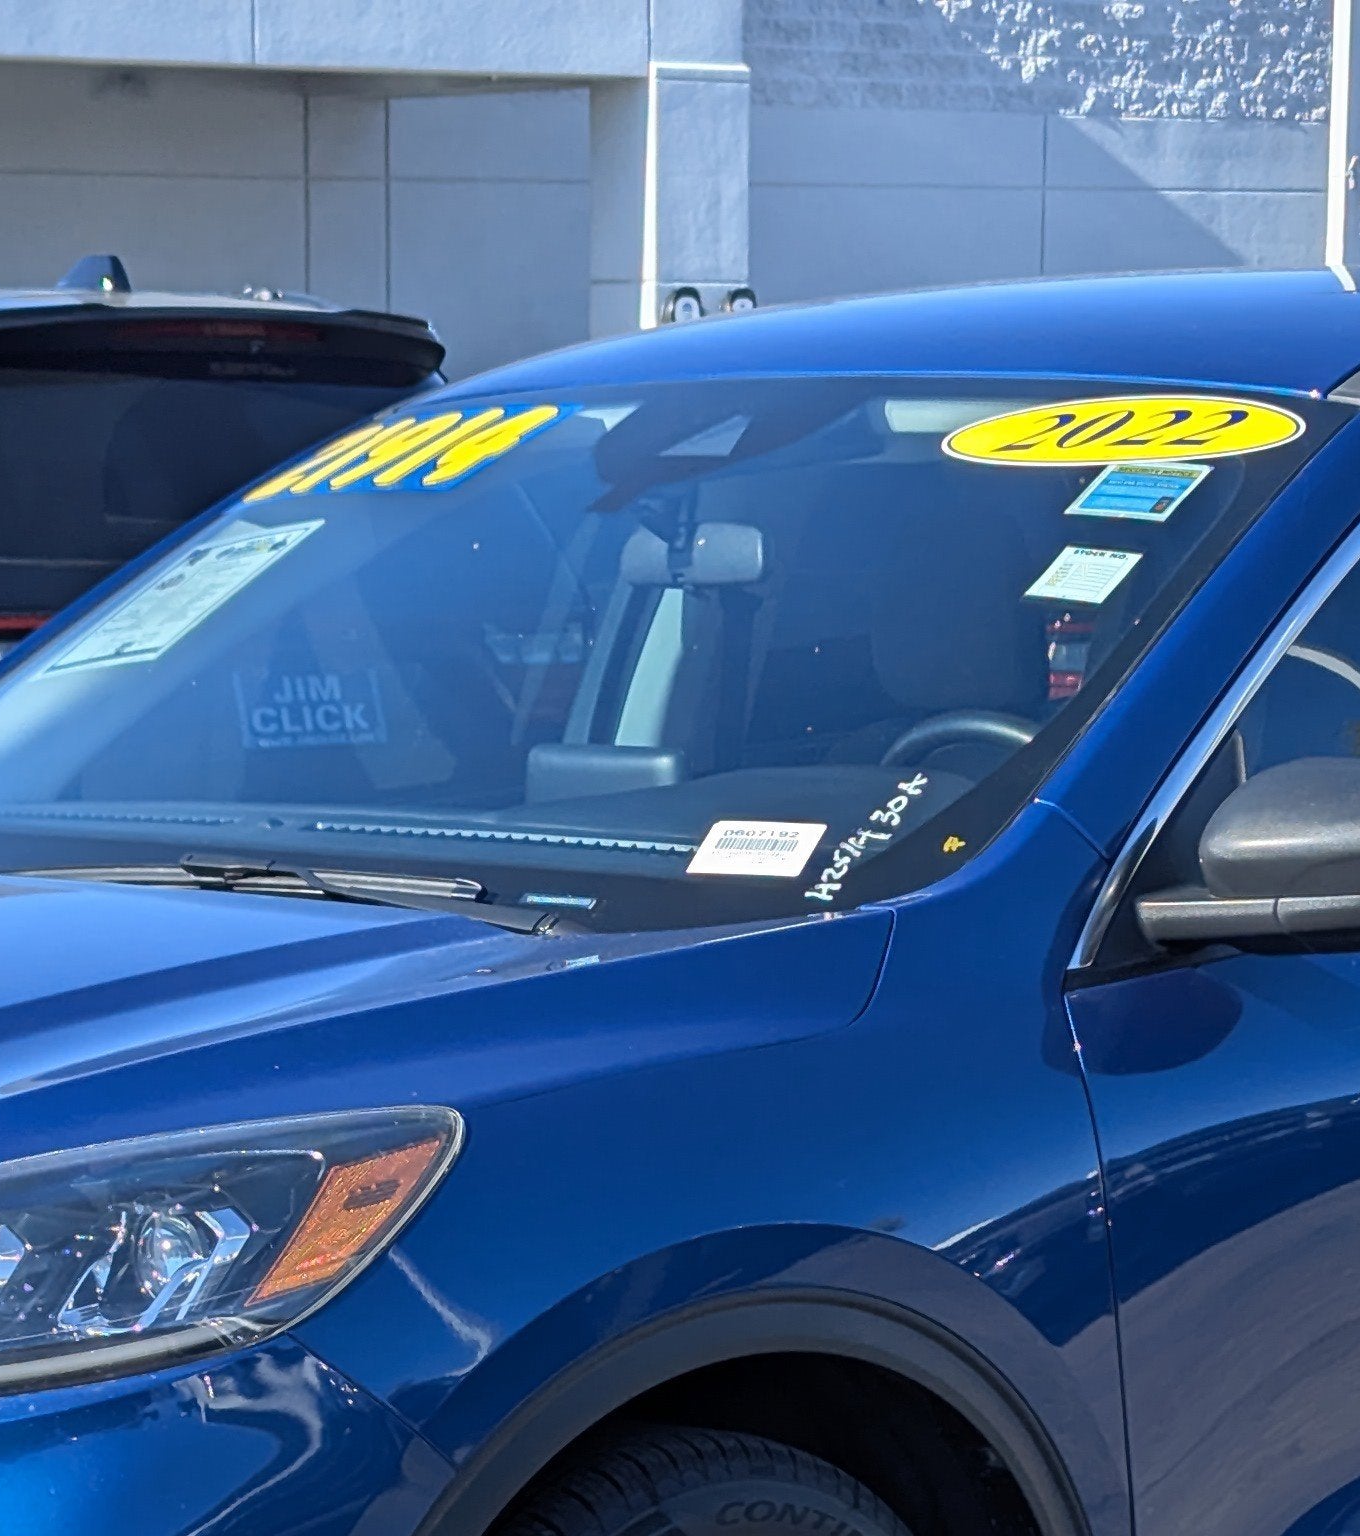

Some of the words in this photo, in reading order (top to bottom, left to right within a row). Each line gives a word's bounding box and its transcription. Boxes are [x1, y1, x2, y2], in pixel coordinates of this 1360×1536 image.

[991, 409, 1249, 453] 2022
[273, 673, 342, 704] JIM
[251, 702, 370, 734] CLICK
